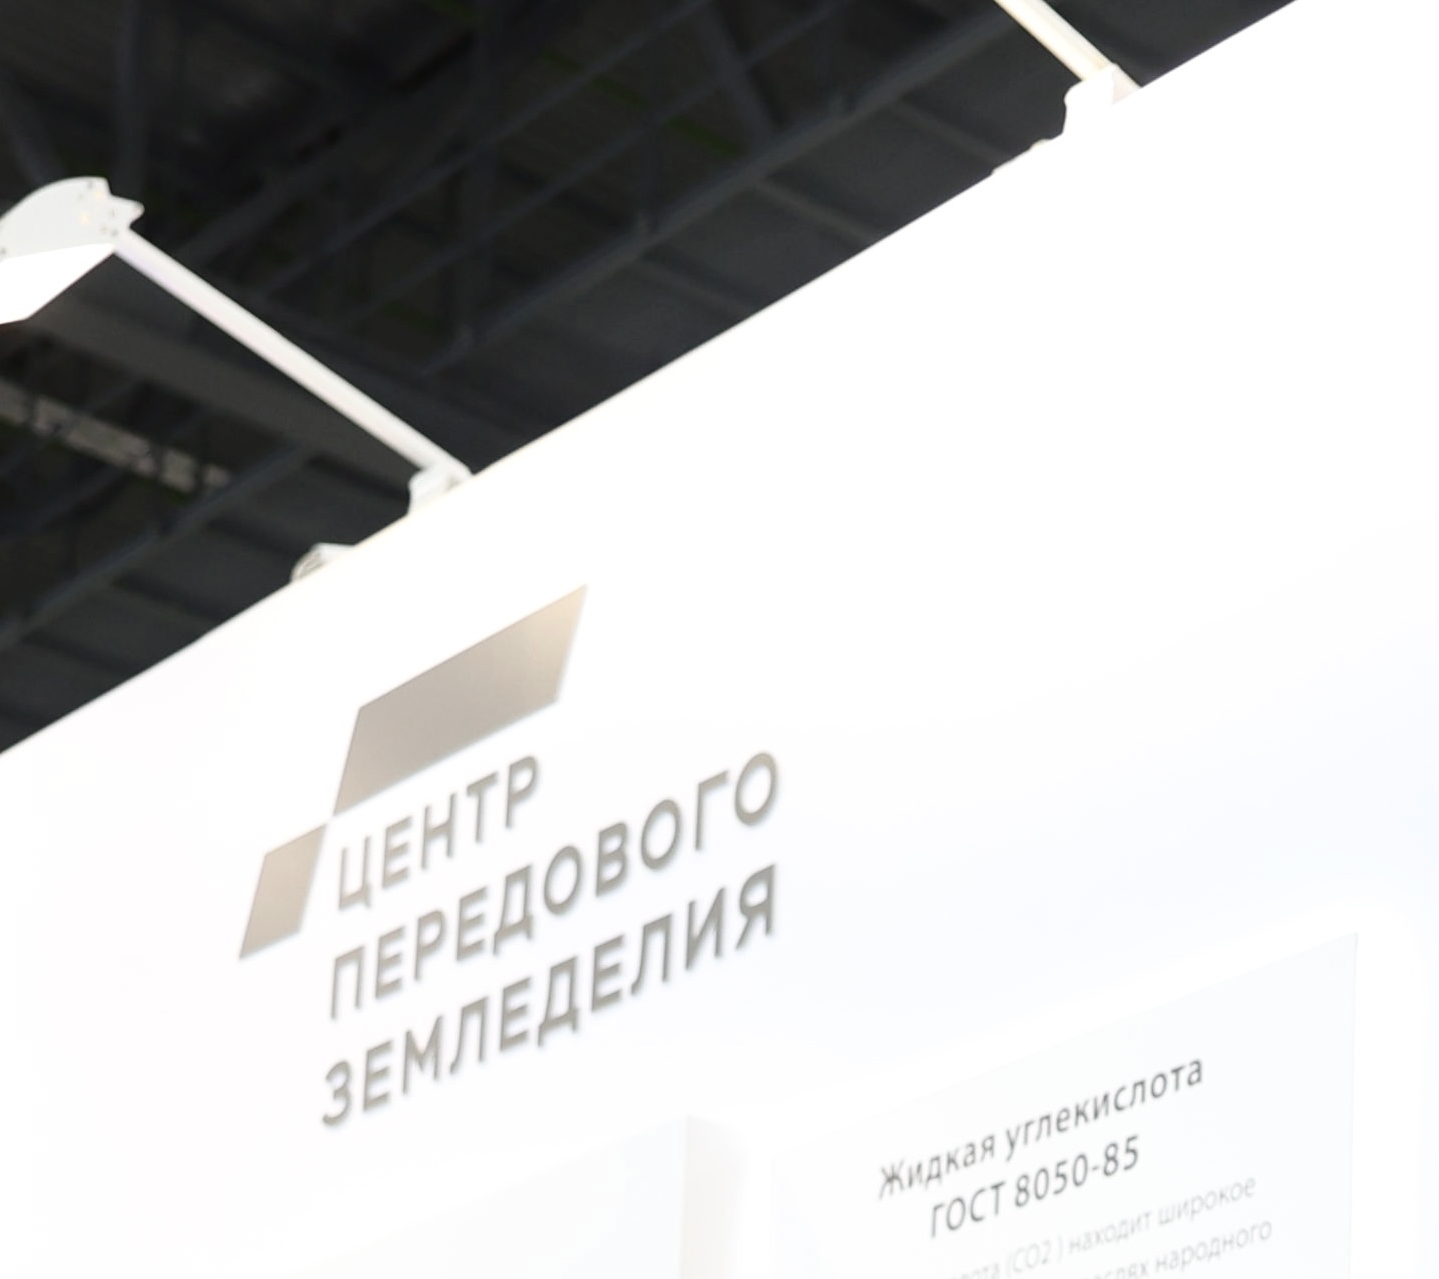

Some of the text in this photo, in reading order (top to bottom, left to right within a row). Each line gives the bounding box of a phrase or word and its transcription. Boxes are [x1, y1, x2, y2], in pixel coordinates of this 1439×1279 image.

[330, 751, 780, 1020] ПЕРЕДОВОГО
[338, 755, 540, 911] ЦЕНТР
[322, 862, 778, 1129] ЗЕМЛЕДЕЛИЯ
[878, 1058, 1203, 1200] Жидкая углекислота
[930, 1134, 1139, 1239] ГОСТ 8050-85
